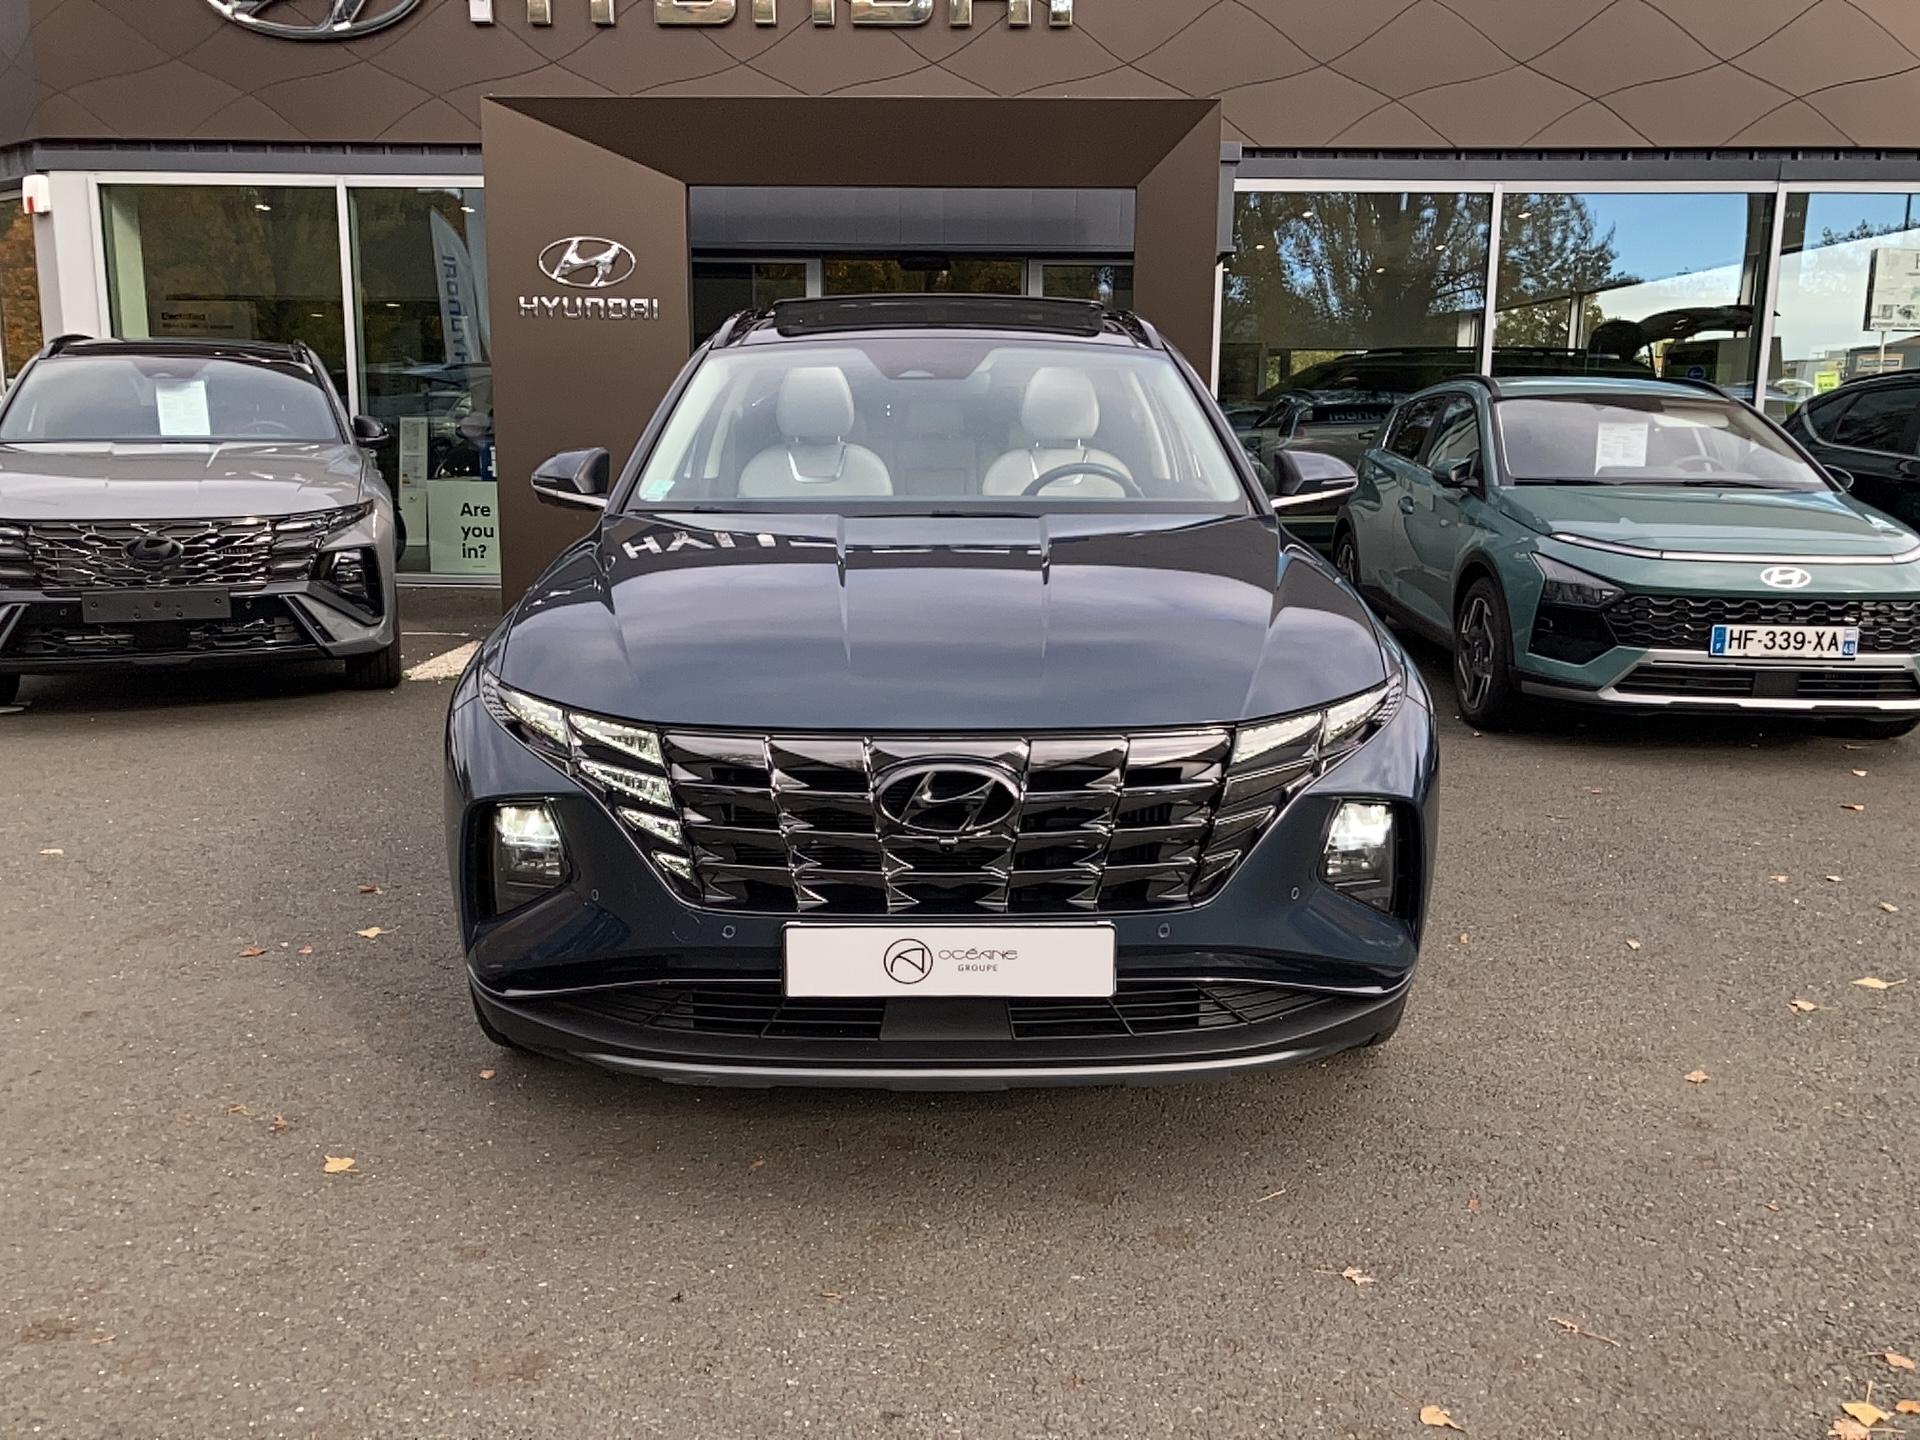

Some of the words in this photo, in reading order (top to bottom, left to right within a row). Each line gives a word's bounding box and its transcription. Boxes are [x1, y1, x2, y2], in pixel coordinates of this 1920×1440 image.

[519, 296, 659, 319] HYUNDAI
[460, 502, 490, 516] Are
[460, 526, 494, 541] you
[462, 543, 487, 559] in?
[1728, 629, 1839, 652] HF-339-XA
[957, 963, 998, 972] GROUPE
